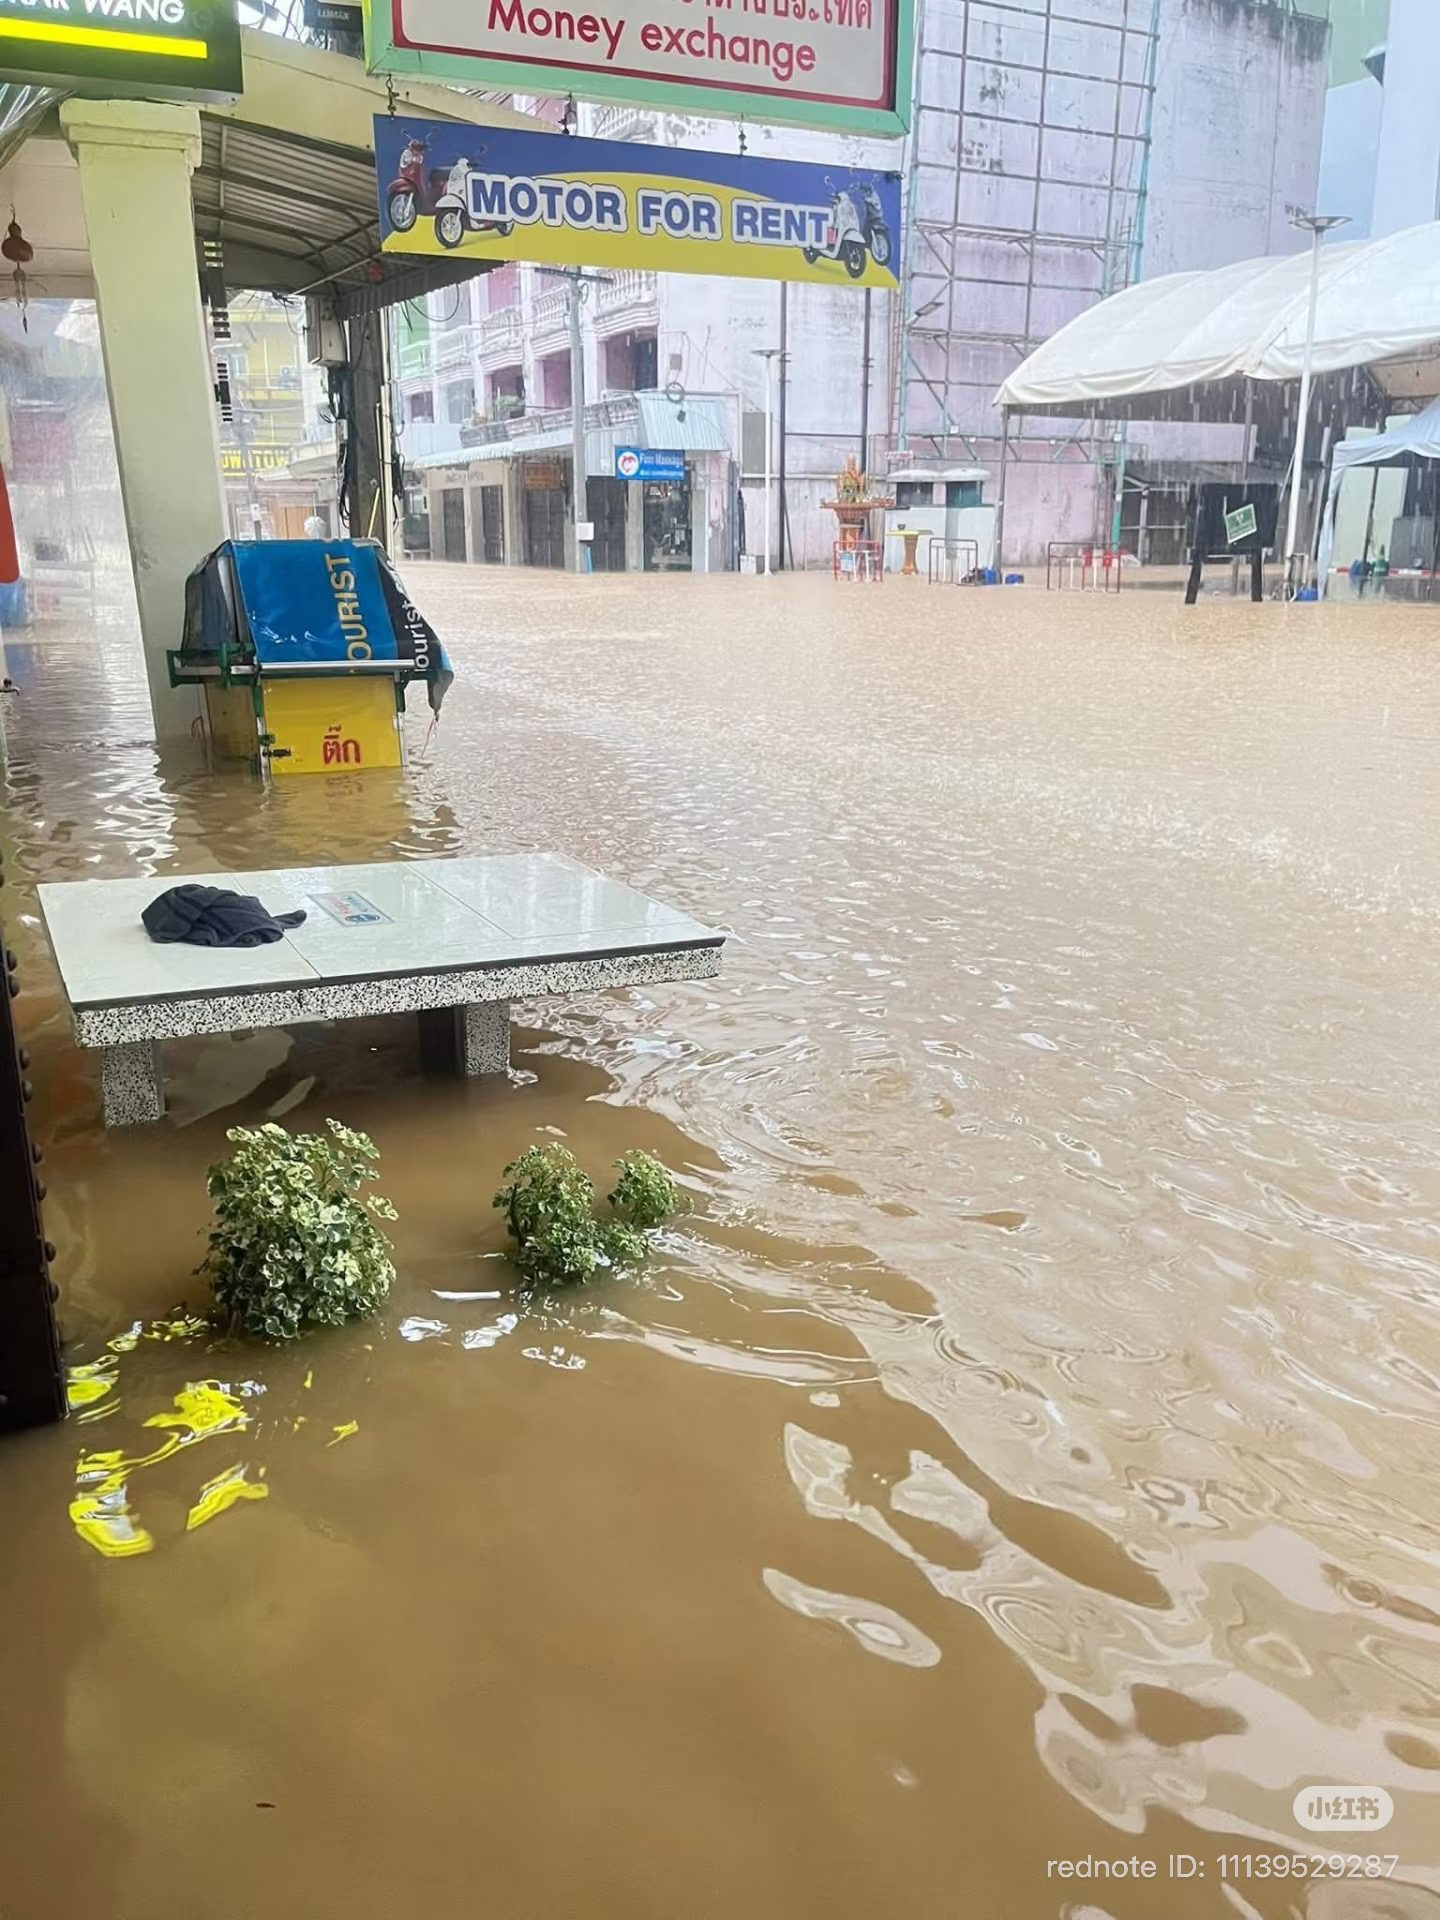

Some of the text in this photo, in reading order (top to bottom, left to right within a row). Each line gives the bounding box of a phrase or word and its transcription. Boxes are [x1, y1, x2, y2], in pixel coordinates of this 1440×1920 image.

[487, 0, 816, 82] Money exchange
[470, 177, 831, 250] MOTOR FOR RENT
[325, 553, 373, 661] OURIST
